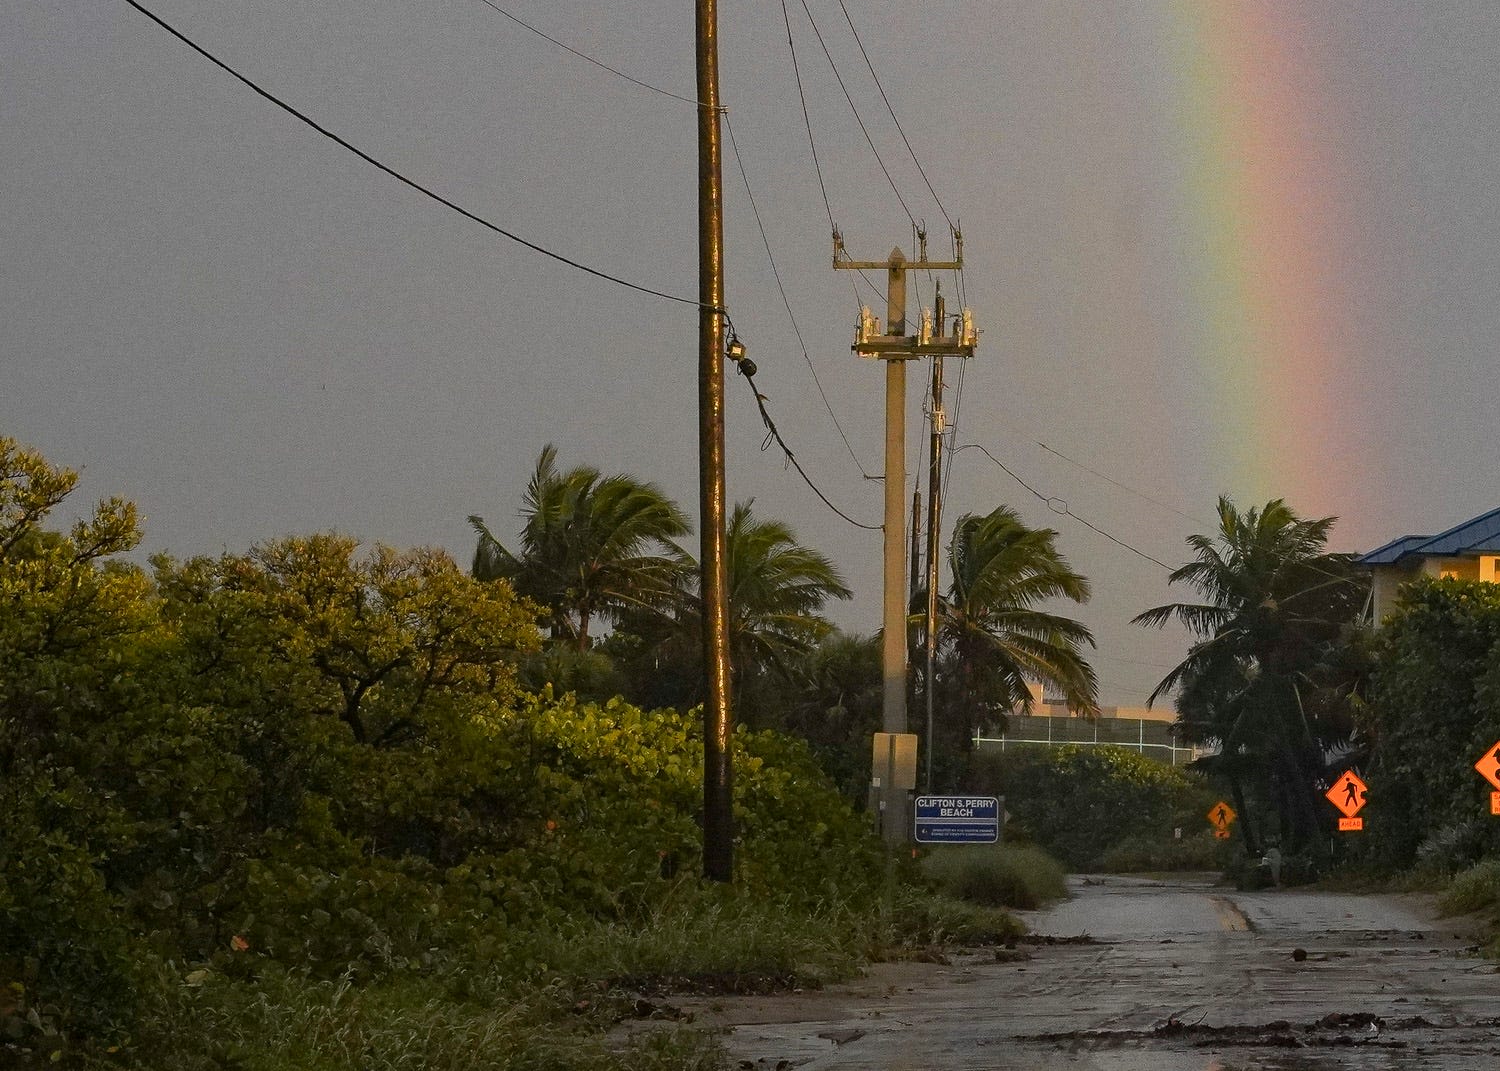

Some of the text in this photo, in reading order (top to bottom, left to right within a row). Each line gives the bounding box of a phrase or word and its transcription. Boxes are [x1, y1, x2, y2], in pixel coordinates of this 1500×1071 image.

[918, 799, 955, 808] CLIFTON
[966, 799, 994, 808] PERRY
[940, 808, 973, 817] BEACH
